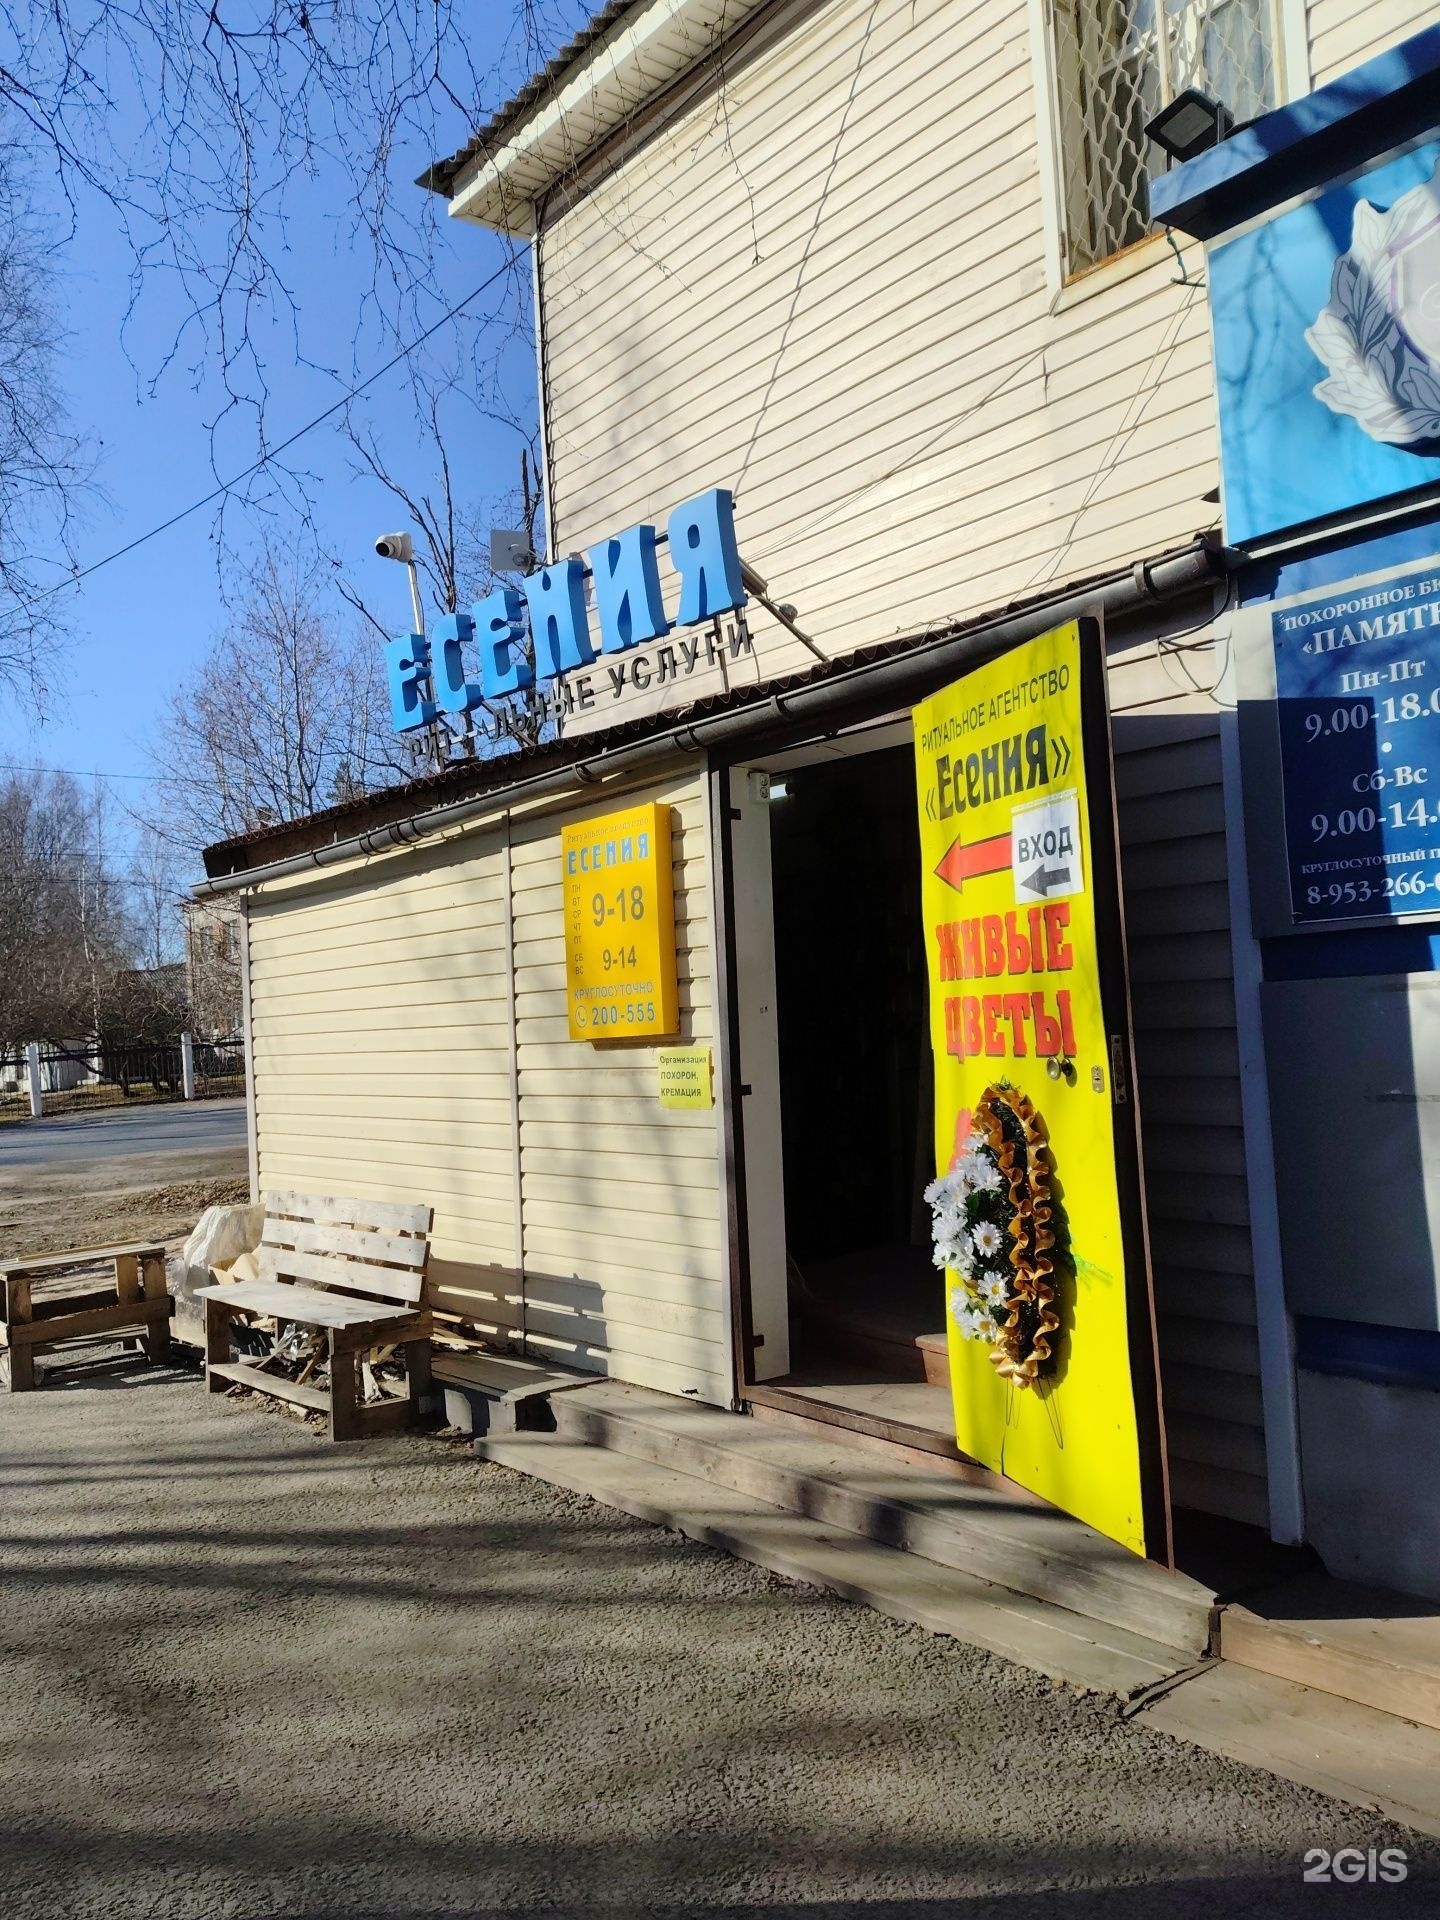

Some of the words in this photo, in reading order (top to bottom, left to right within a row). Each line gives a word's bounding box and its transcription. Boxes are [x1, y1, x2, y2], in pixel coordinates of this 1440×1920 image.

[384, 488, 748, 732] ЕСЕНИЯ
[1284, 585, 1415, 631] ПОХОРОННОЕ
[409, 677, 595, 766] РИТАЛЬНЫЕ
[608, 622, 752, 698] УСЛУГИ
[1342, 660, 1426, 693] Пн-Пт
[922, 702, 985, 755] РИТУАЛЬНОЕ
[989, 664, 1070, 722] АГЕНТСТВО
[1352, 765, 1428, 793] Сб-Вс
[1311, 798, 1440, 843] 9.00-14.
[567, 832, 649, 875] ЕСЕНИЯ
[1017, 825, 1073, 864] ВХОД
[592, 885, 645, 927] 9-18
[603, 945, 637, 971] 9-14
[936, 902, 1073, 982] ЖИВЫЕ
[574, 981, 653, 1001] КРУГЛОСУТОЧНО
[591, 1002, 655, 1026] 200-555
[944, 990, 1077, 1063] ЦВЕТЫ
[660, 1056, 706, 1065] Организация
[661, 1071, 698, 1082] ПОХОРОН,
[661, 1088, 701, 1098] КРЕМАЦИЯ
